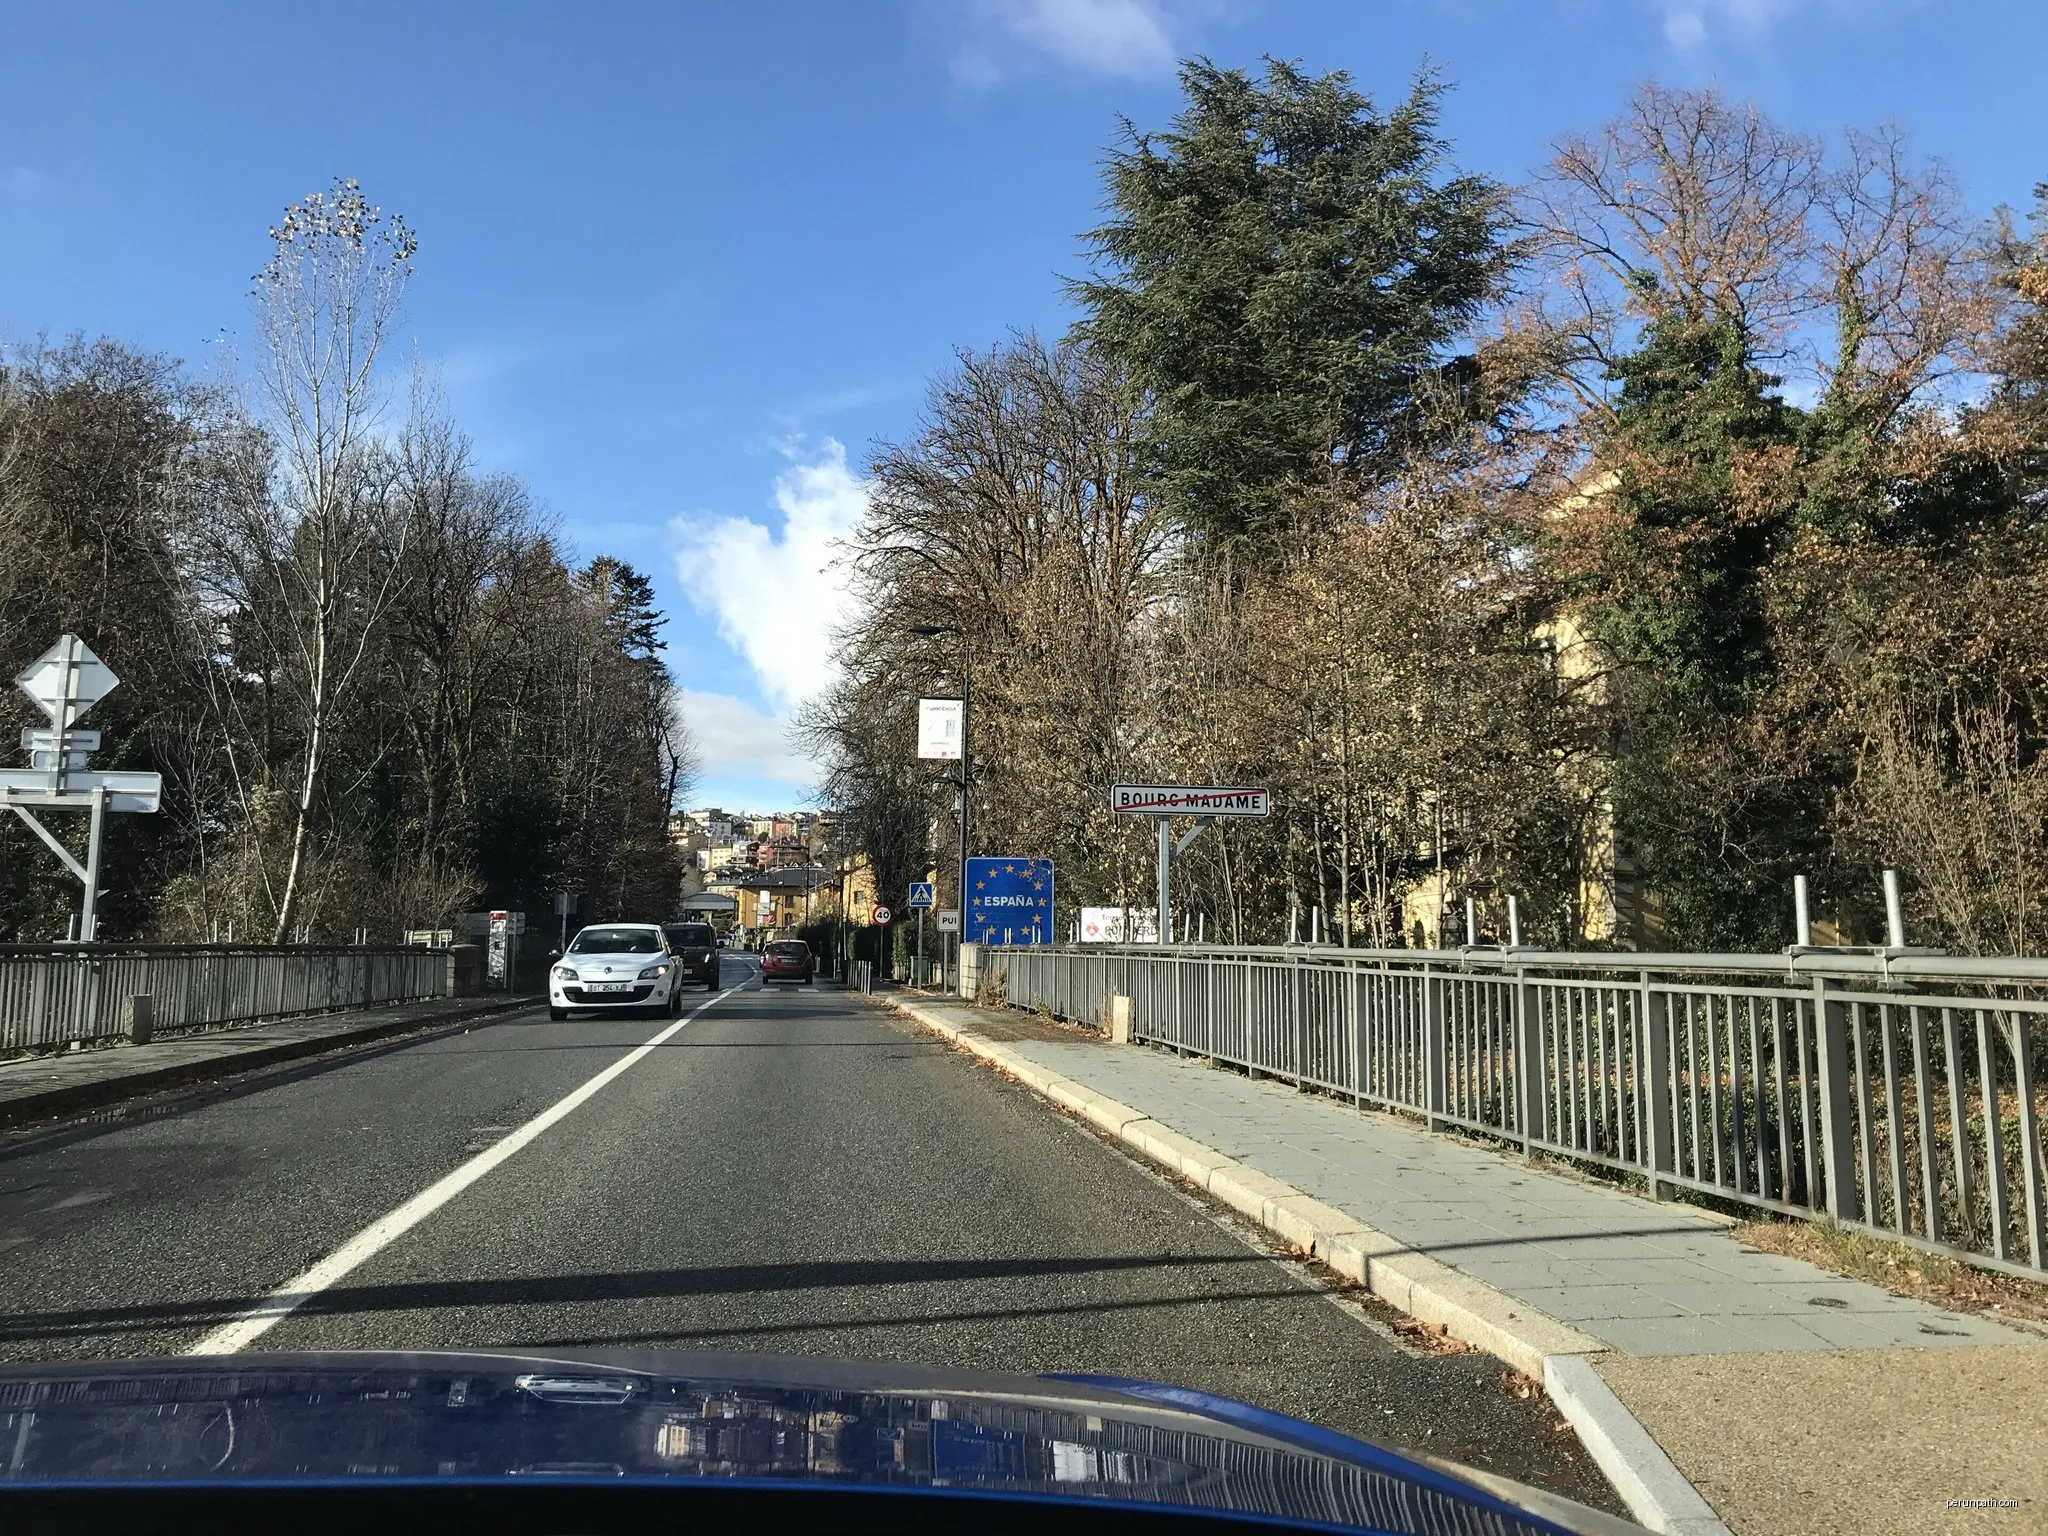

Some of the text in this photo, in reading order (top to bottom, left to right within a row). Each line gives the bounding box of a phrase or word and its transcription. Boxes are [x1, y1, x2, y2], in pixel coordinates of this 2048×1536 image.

[1186, 793, 1261, 809] MADAME
[984, 894, 1034, 907] ESPAÑA
[876, 911, 890, 919] 40
